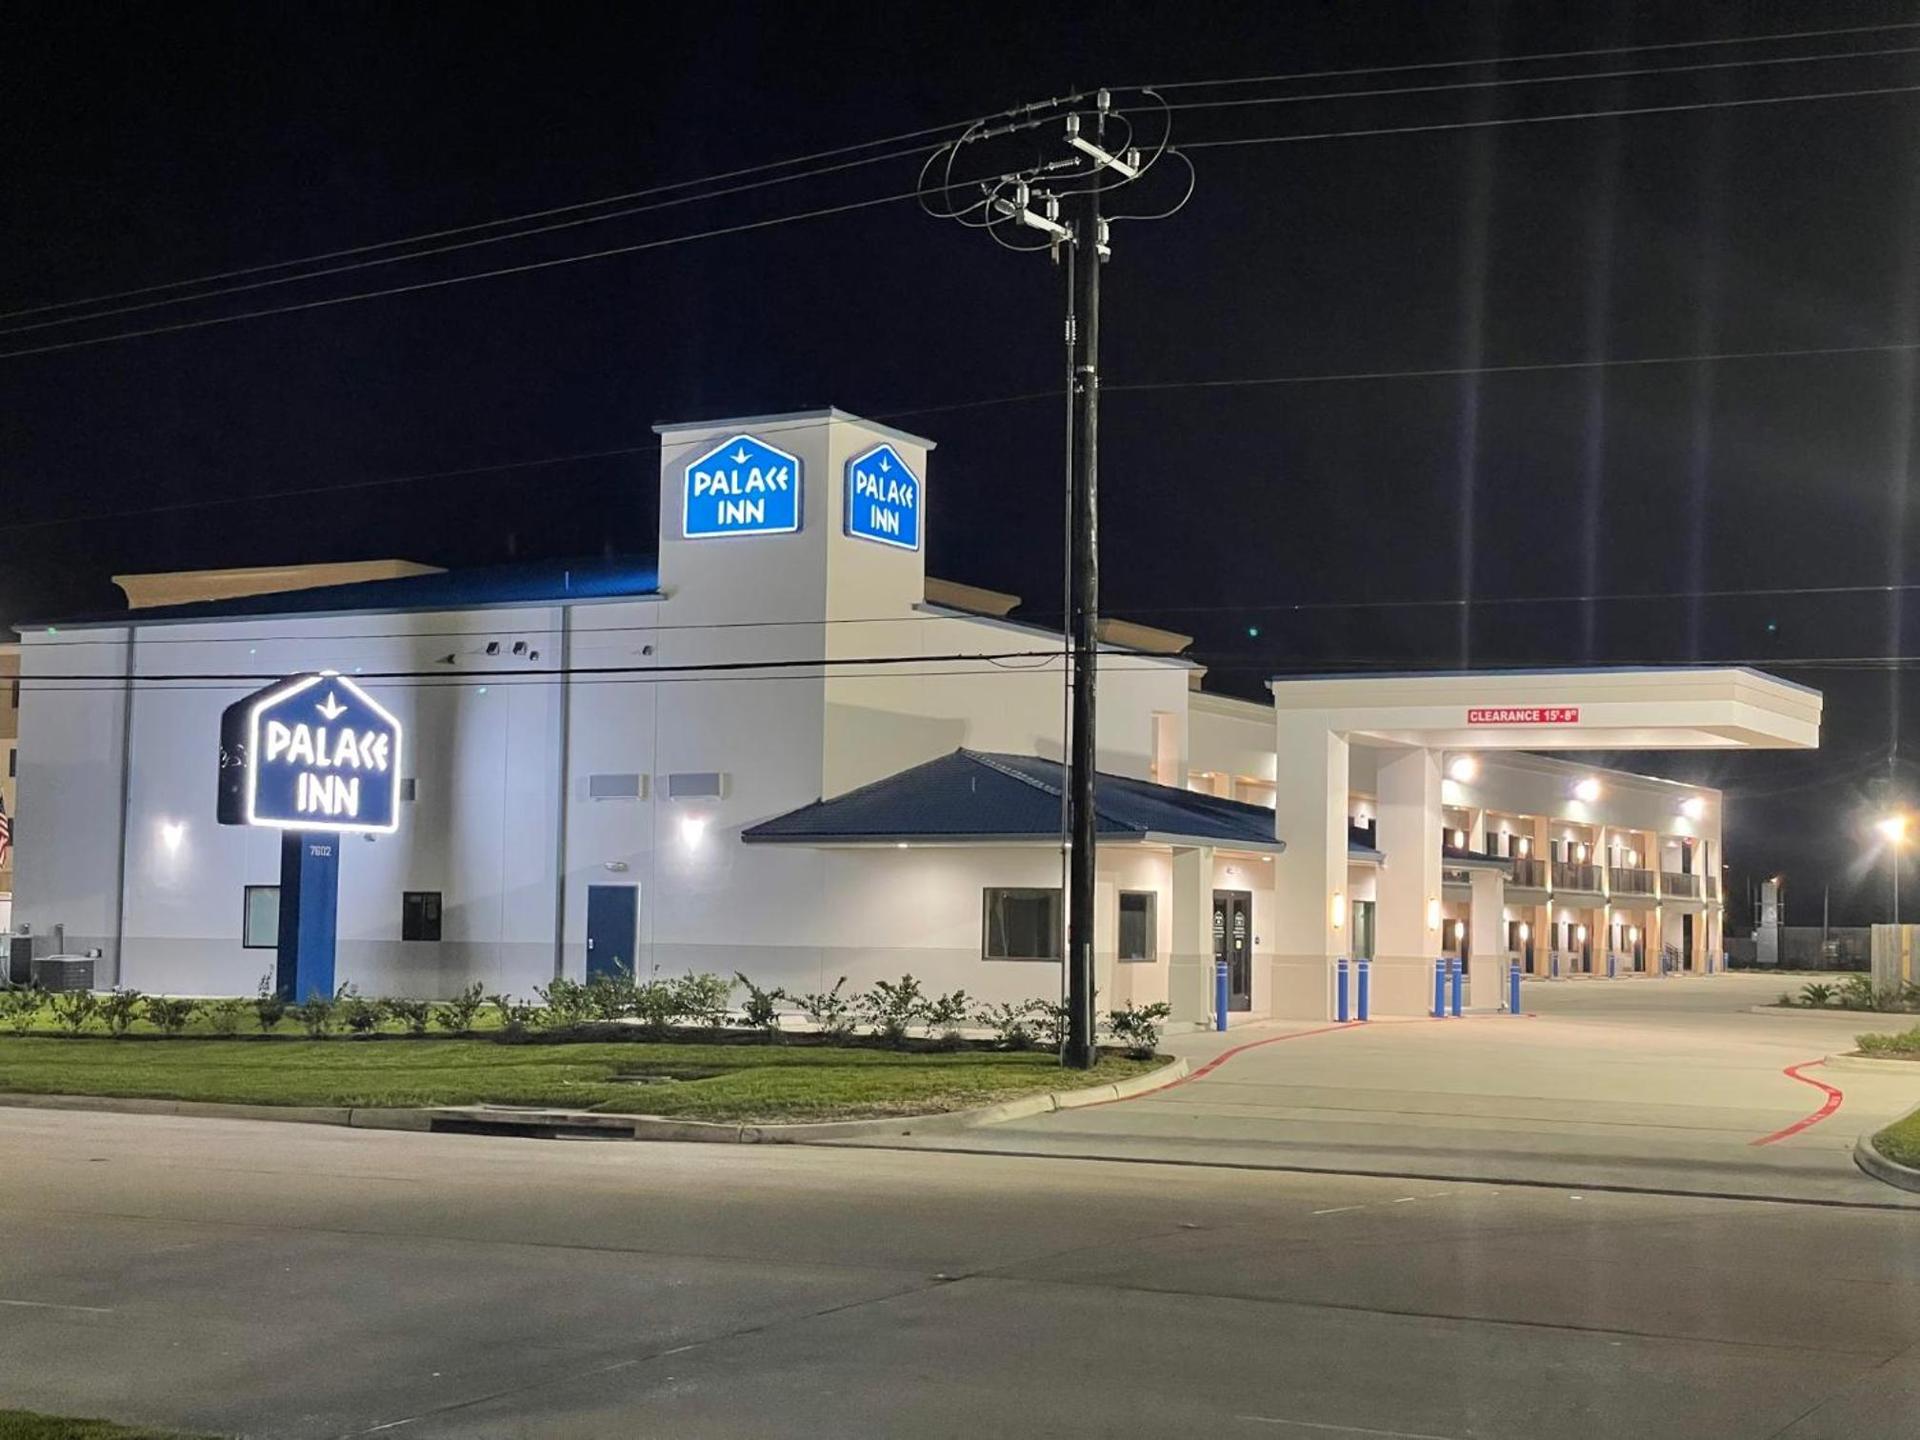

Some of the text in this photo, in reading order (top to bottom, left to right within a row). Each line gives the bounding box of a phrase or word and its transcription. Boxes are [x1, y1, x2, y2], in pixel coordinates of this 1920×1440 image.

[694, 466, 789, 496] PALACE
[856, 469, 913, 509] PALACE
[717, 498, 765, 525] INN
[870, 504, 900, 536] INN
[1469, 710, 1541, 722] CLEARANCE
[266, 720, 389, 772] PALACE
[297, 771, 360, 817] INN
